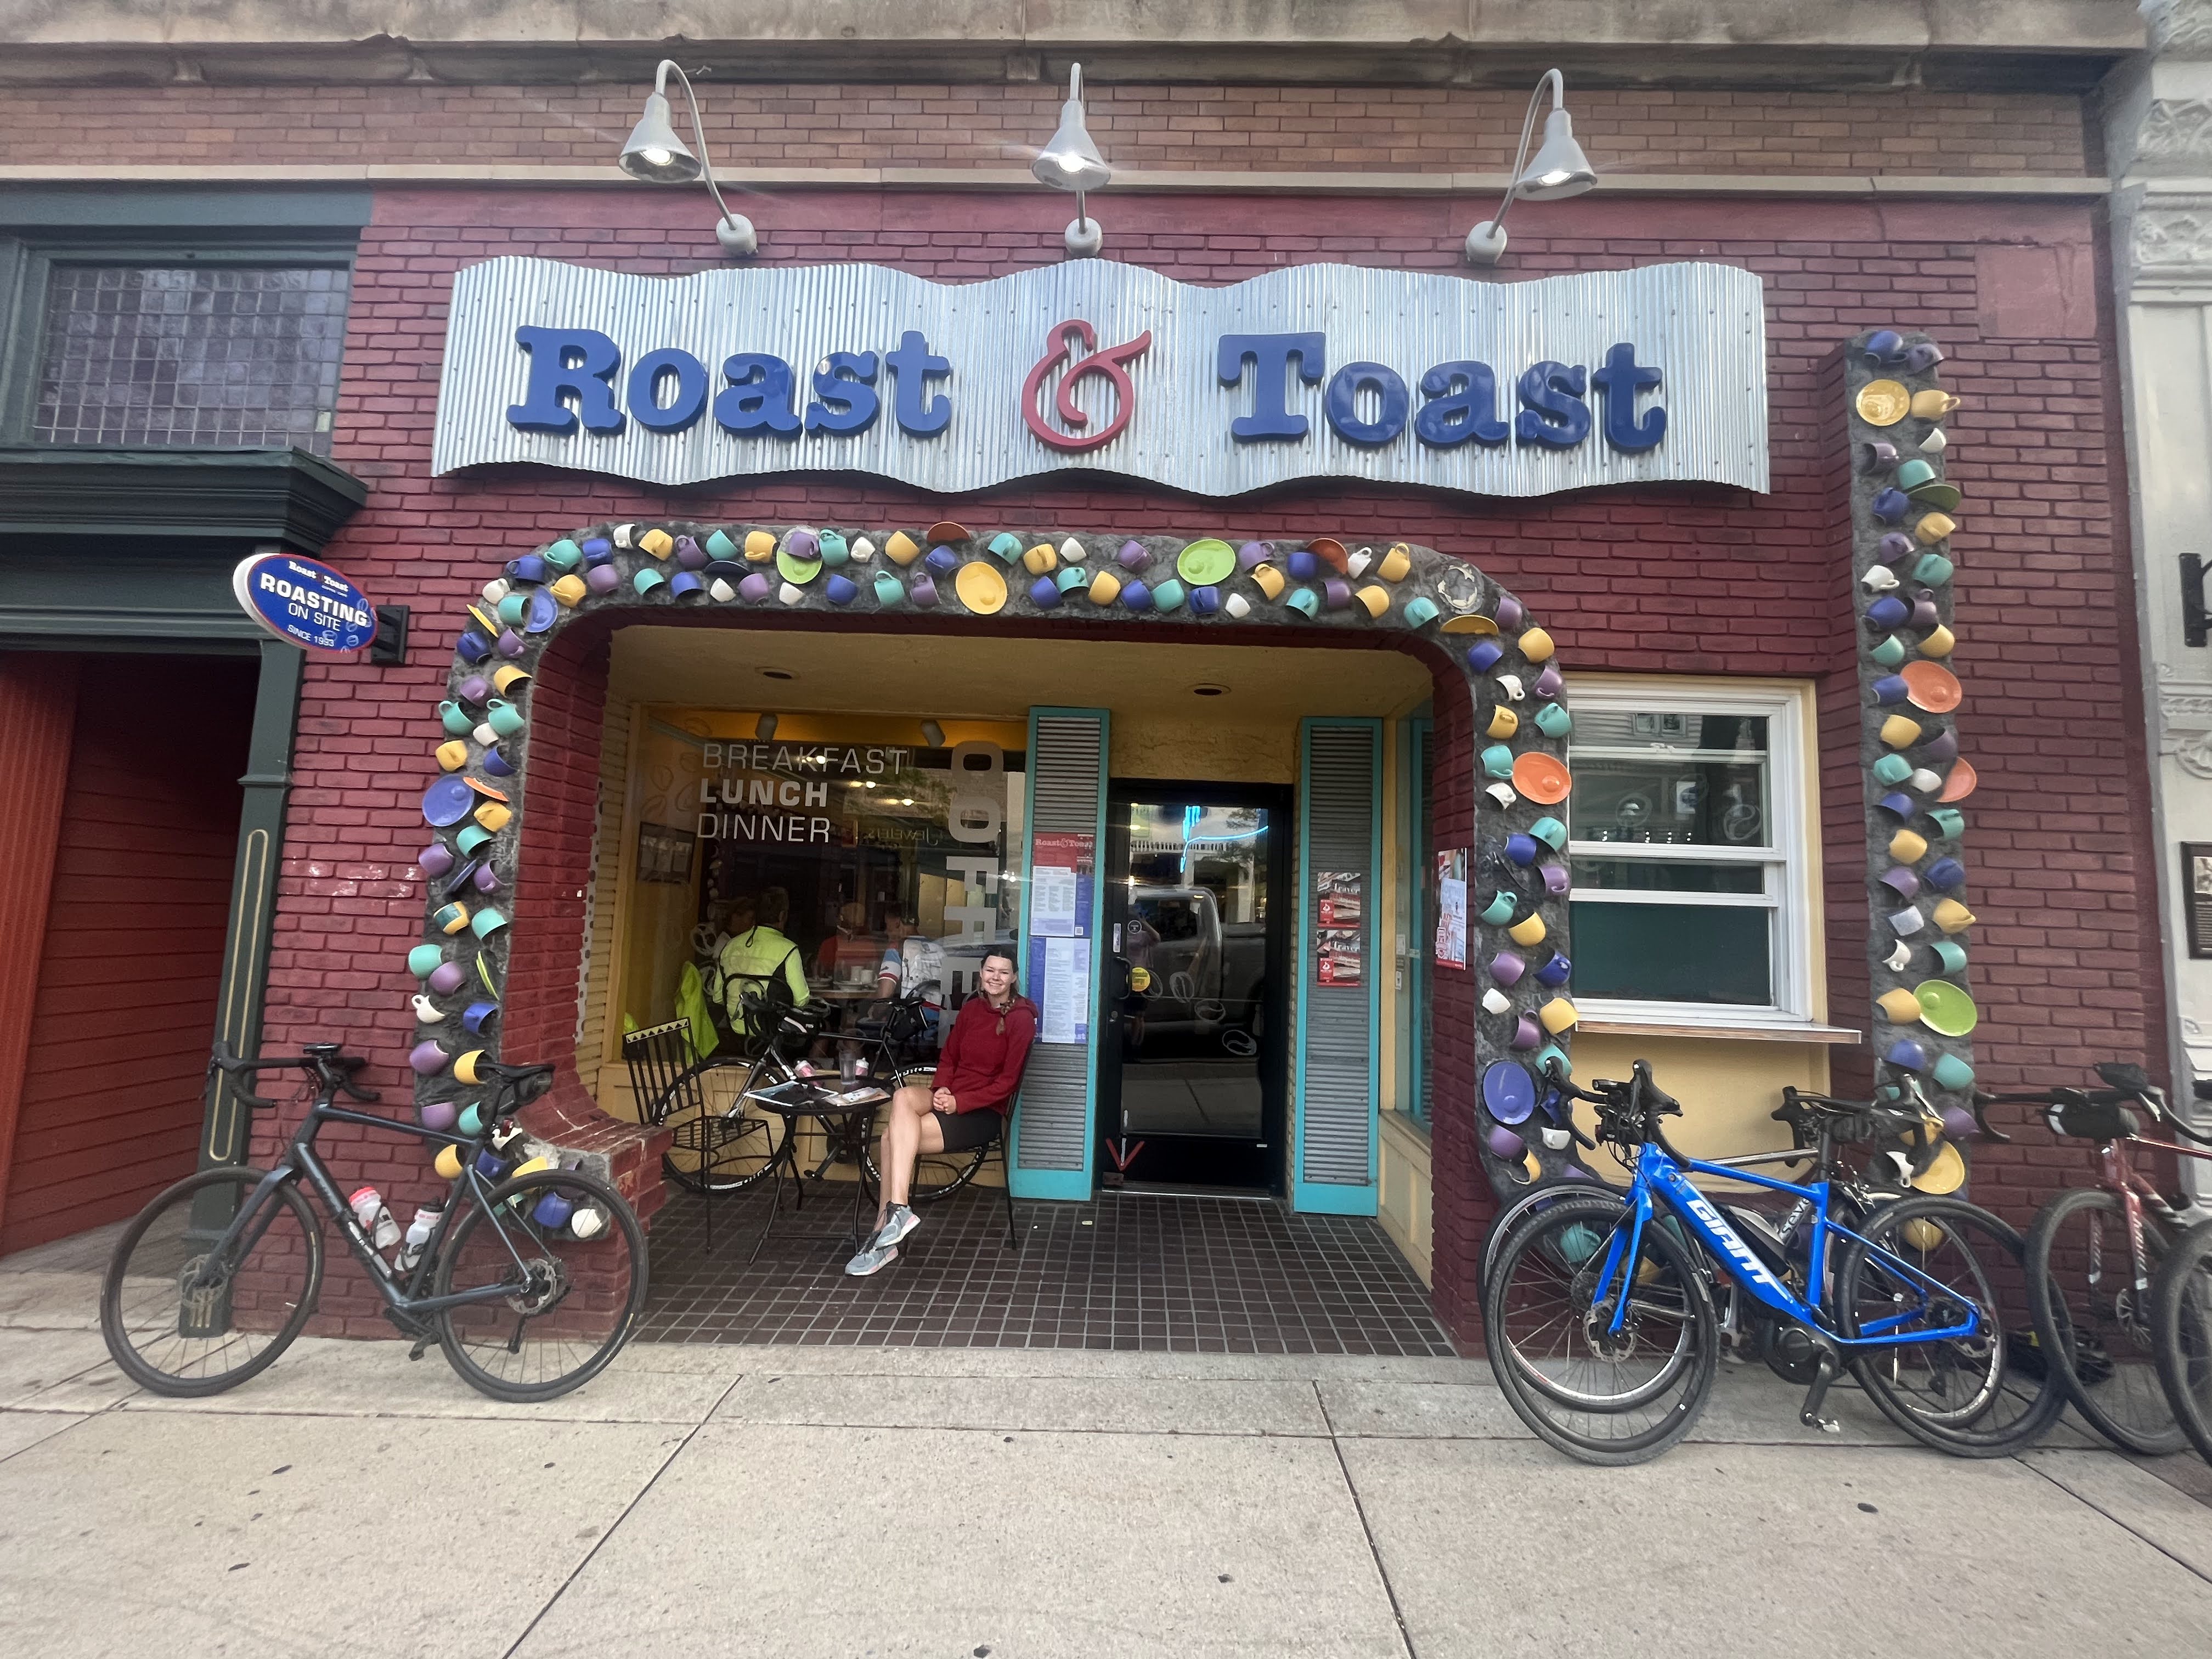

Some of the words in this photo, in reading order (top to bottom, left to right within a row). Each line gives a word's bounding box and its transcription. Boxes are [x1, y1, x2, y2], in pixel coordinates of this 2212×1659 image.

[506, 324, 953, 440] Roast
[1021, 318, 1152, 454] &
[1217, 330, 1667, 454] Toast
[288, 560, 317, 579] Roast
[323, 575, 349, 592] Toast
[260, 572, 368, 627] ROASTING
[287, 602, 309, 620] ON
[313, 611, 342, 632] SITE
[287, 624, 311, 642] SINCE
[314, 635, 335, 647] 1993
[703, 742, 907, 775] BREAKFAST
[699, 778, 828, 808] LUNCH
[697, 813, 831, 843] DINNER
[1685, 1199, 1775, 1285] GIANT
